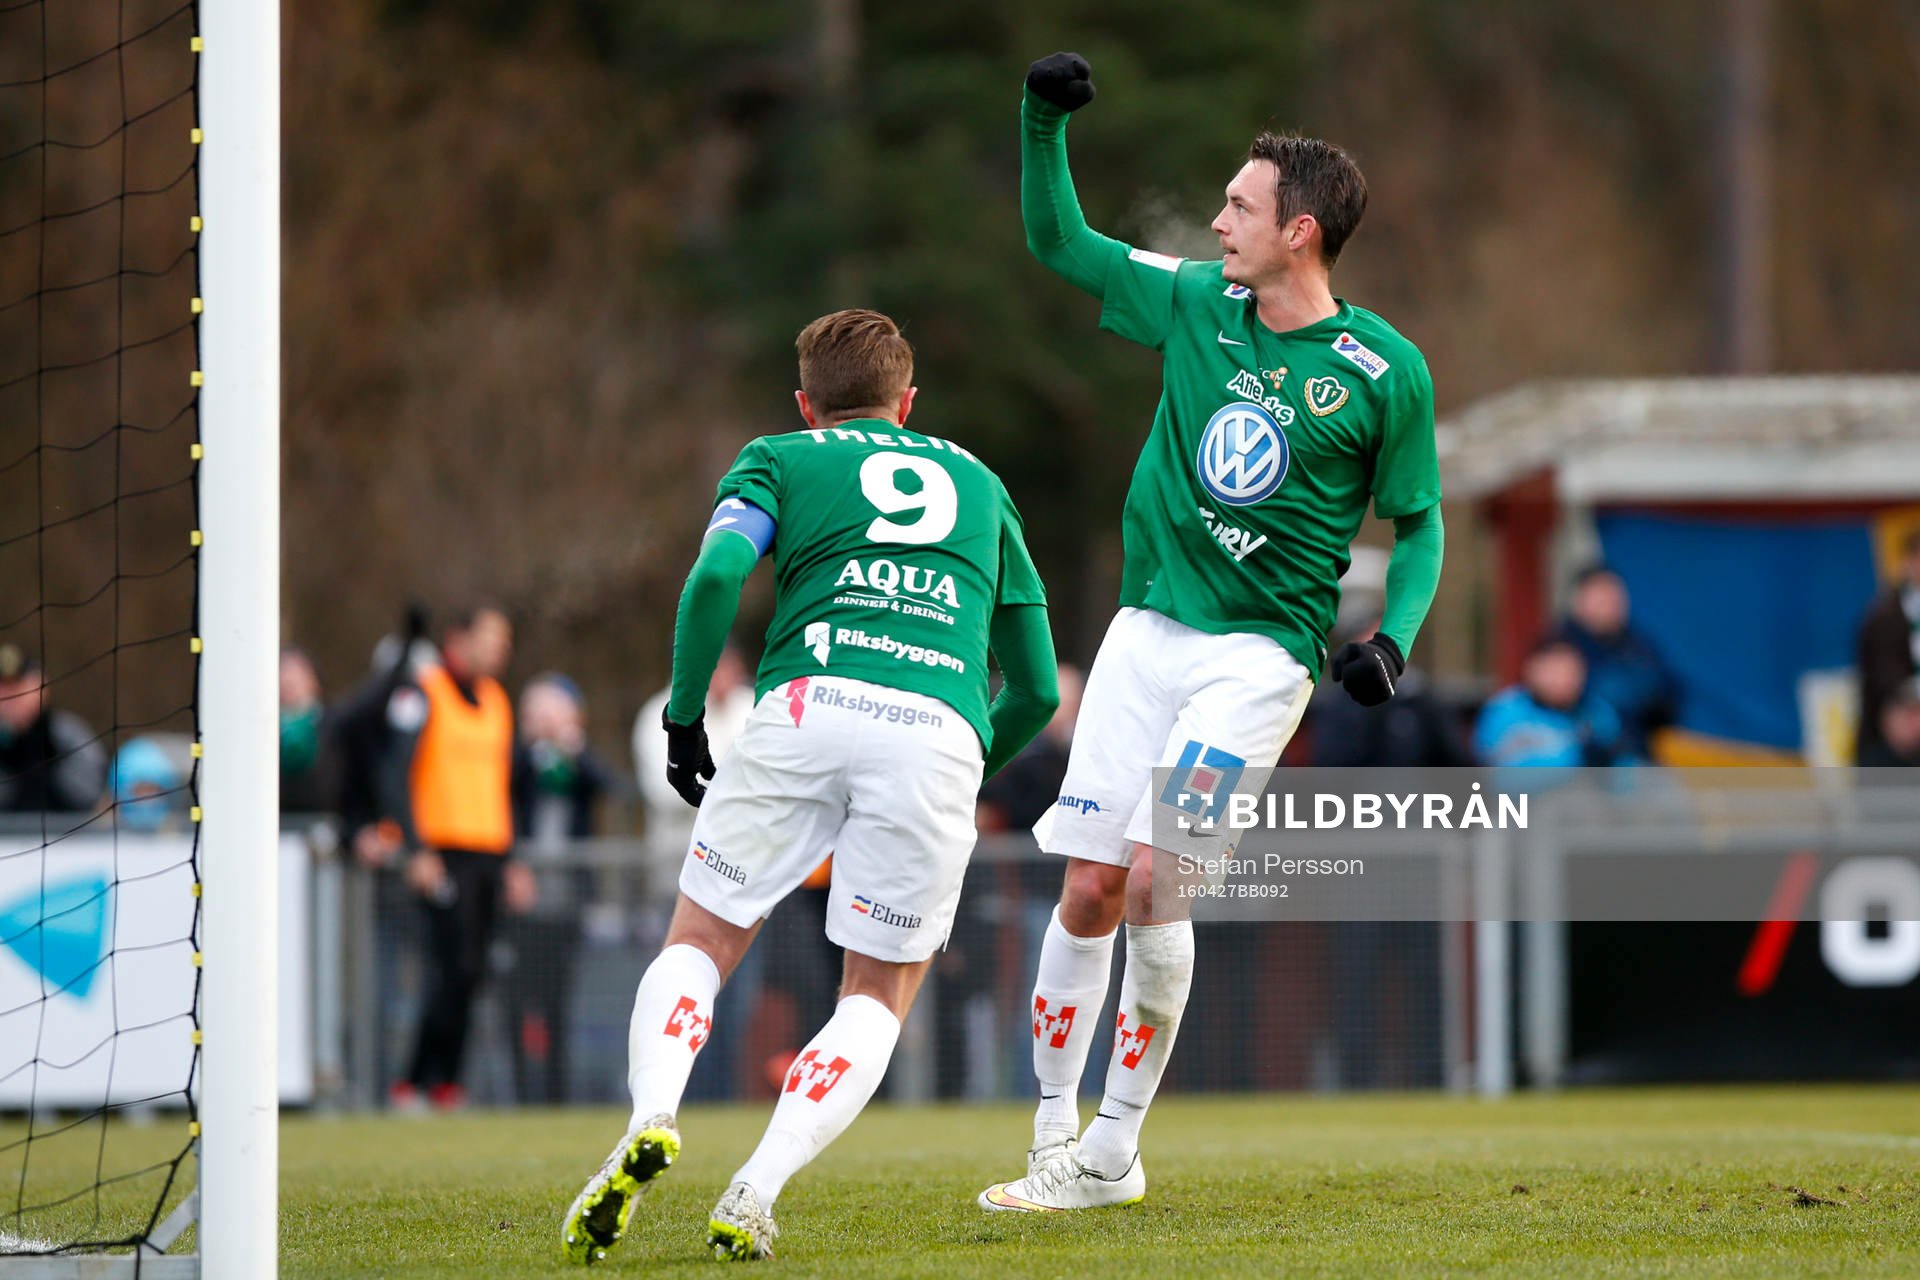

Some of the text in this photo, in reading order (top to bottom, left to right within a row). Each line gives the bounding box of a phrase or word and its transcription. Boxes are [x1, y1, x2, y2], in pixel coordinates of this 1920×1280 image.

[1351, 354, 1379, 375] SPORT
[1357, 347, 1385, 370] INTER
[859, 451, 959, 545] 9
[834, 559, 961, 608] AQUA
[833, 596, 955, 625] DINNER & DRINKS
[835, 628, 965, 674] Riksbyggen
[812, 685, 943, 728] Riksbyggen
[705, 849, 747, 886] Elmia
[870, 903, 922, 929] Elmia
